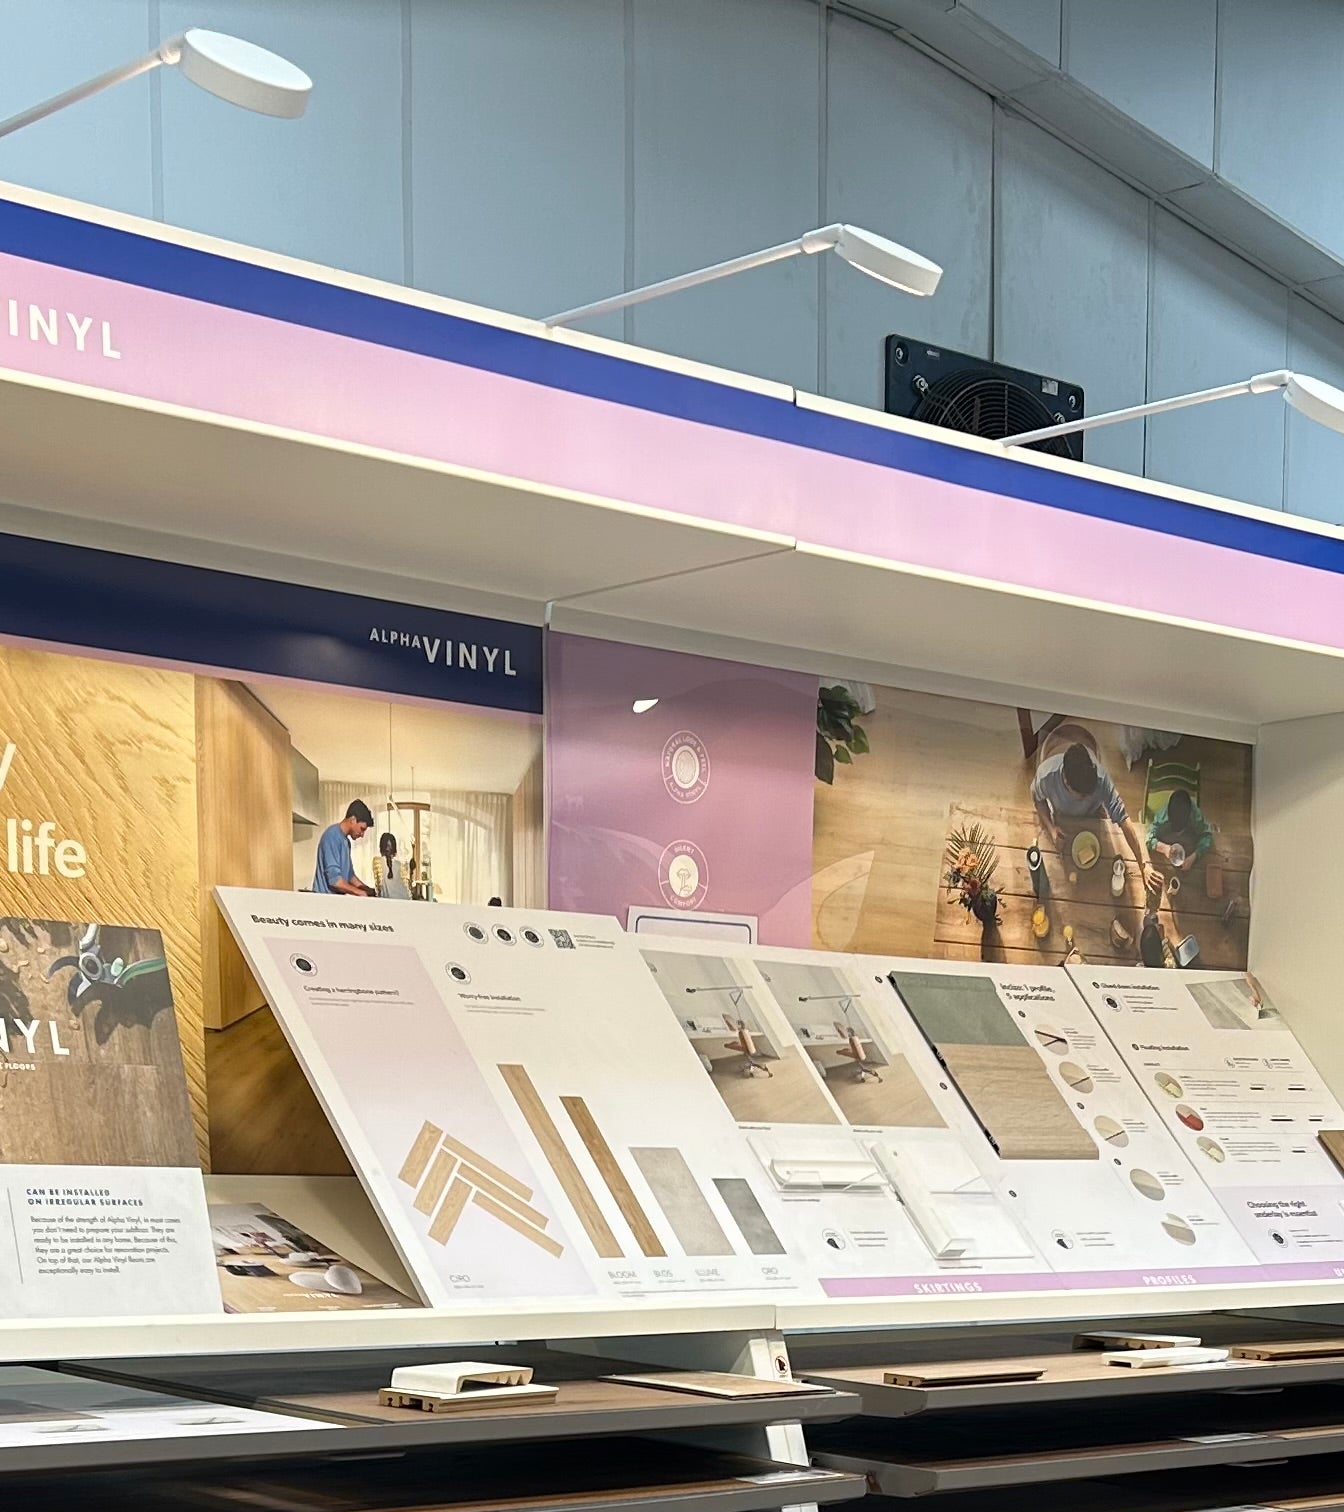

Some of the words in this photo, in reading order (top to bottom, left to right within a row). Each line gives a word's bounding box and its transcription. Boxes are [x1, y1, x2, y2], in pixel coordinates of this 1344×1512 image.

[369, 627, 423, 650] ALPHA
[423, 635, 518, 678] VINYL
[7, 819, 87, 878] life
[250, 914, 290, 927] Beauty
[291, 918, 326, 928] comes
[327, 919, 338, 929] in
[339, 922, 367, 932] many
[369, 923, 394, 933] sizes
[26, 1188, 46, 1196] CAN
[49, 1188, 59, 1196] BE
[62, 1188, 110, 1197] INSTALLED
[45, 1198, 96, 1206] IRREGULAR
[100, 1198, 143, 1206] SURFACES
[1142, 1274, 1197, 1286] PROFILES
[914, 1281, 983, 1293] SKIRTINGS
